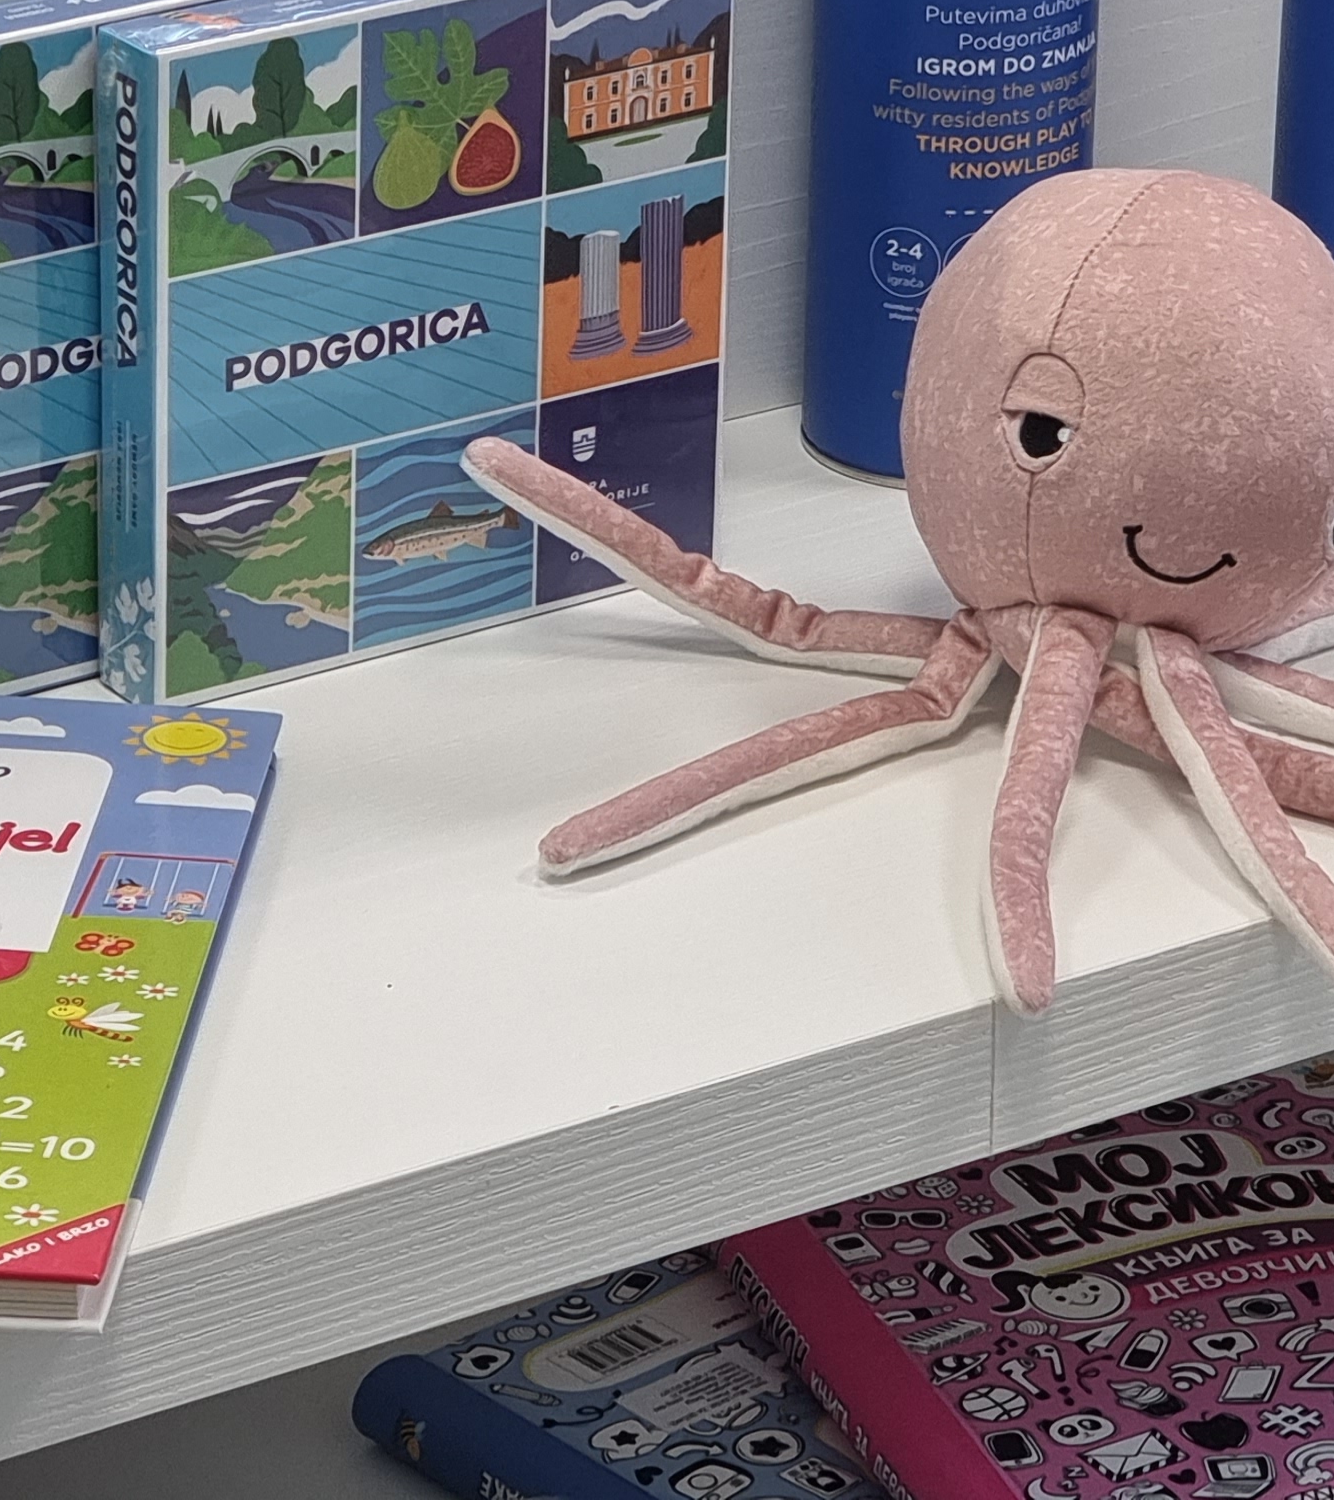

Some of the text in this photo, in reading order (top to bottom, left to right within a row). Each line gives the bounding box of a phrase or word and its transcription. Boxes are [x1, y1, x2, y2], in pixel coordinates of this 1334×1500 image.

[925, 5, 1027, 26] Putevima
[959, 15, 1082, 52] Podgoričana!
[917, 56, 995, 77] IGROM
[1003, 54, 1036, 74] DO
[888, 78, 995, 105] Following
[1002, 81, 1035, 100] the
[1041, 72, 1079, 97] ways
[872, 103, 925, 128] witty
[932, 110, 1030, 129] residents
[1035, 101, 1056, 123] of
[916, 133, 1030, 154] THROUGH
[1036, 120, 1078, 147] PLAY
[949, 142, 1081, 180] KNOWLEDGE
[114, 71, 138, 369] PODGORICA
[885, 239, 923, 261] 2-4
[892, 261, 916, 276] broj
[224, 301, 491, 394] PODGORICA
[605, 483, 650, 500] ORIJE
[1005, 1132, 1226, 1207] МОЈ
[44, 1237, 55, 1246] I
[56, 1217, 110, 1242] BRZO
[1113, 1225, 1315, 1280] КЊИГА ЗА
